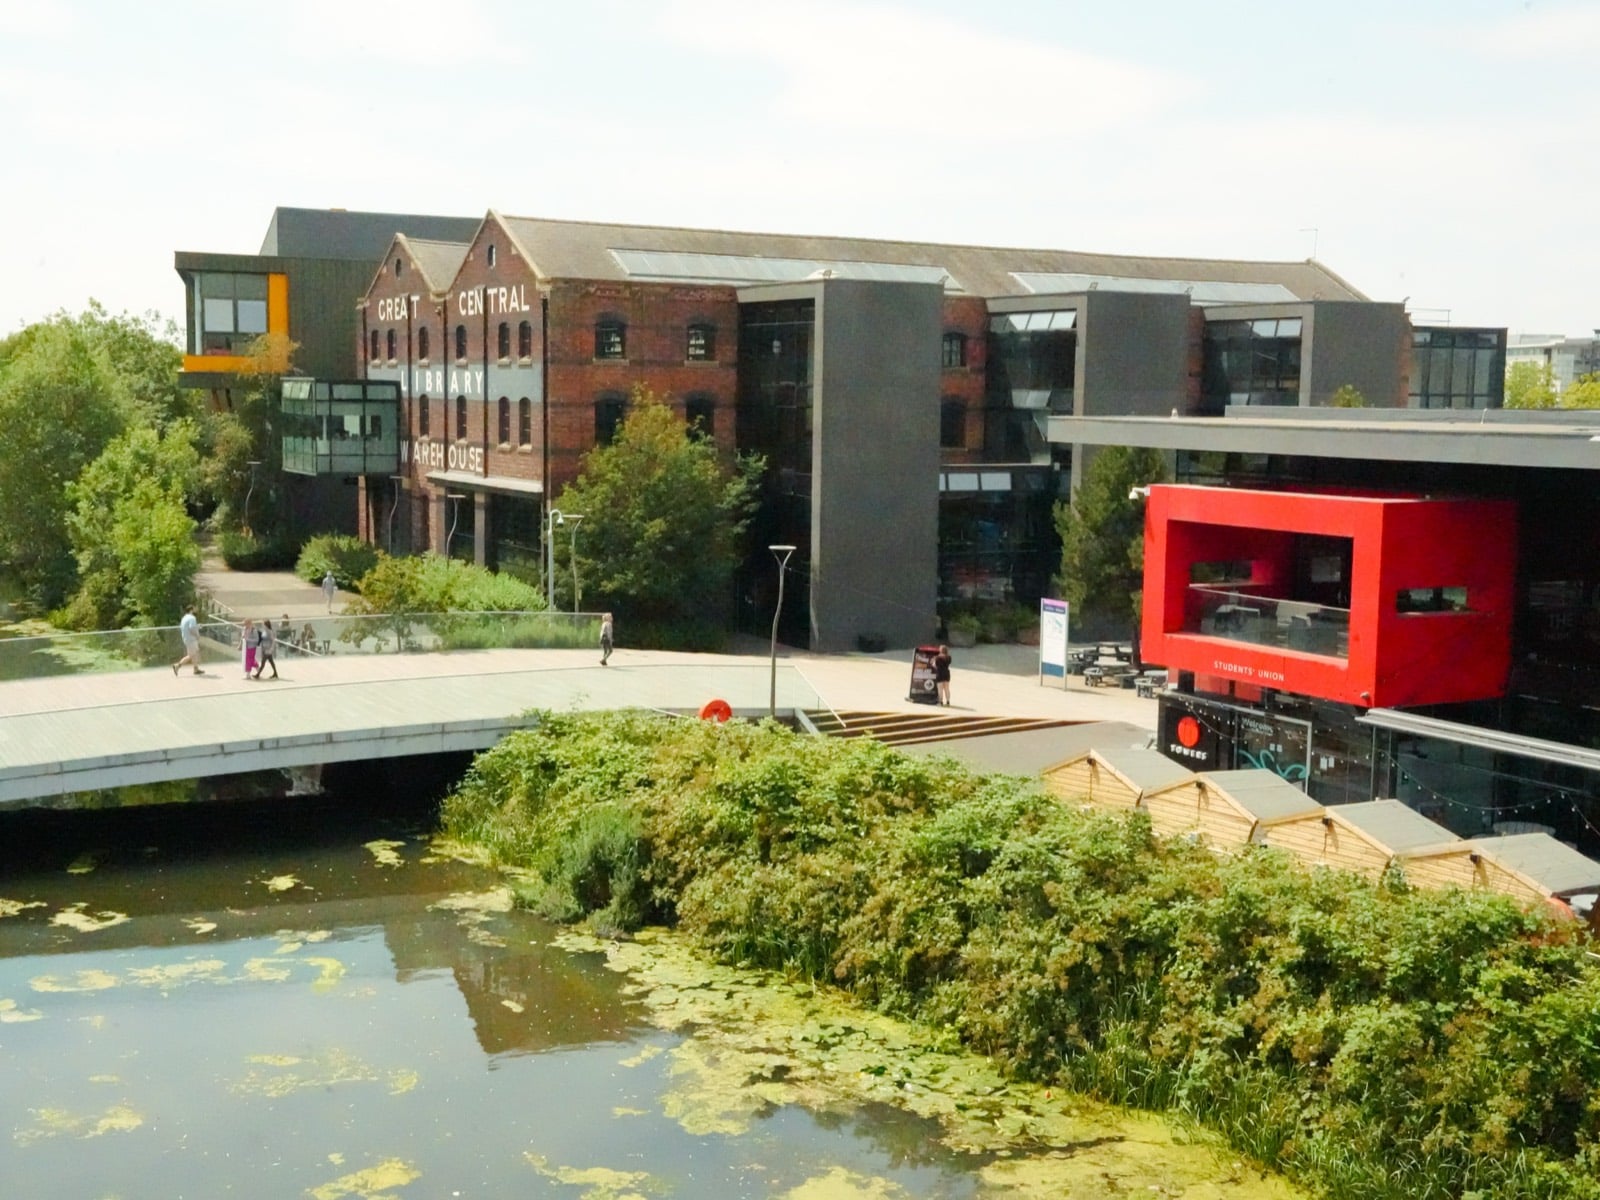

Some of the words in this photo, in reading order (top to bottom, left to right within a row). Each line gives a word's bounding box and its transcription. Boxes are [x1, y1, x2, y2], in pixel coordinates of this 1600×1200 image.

[378, 295, 420, 321] GREAT
[458, 284, 530, 316] CENTRAL
[401, 370, 484, 394] LIBRARY
[400, 440, 484, 472] WAREHOUSE
[1258, 669, 1285, 681] UNION
